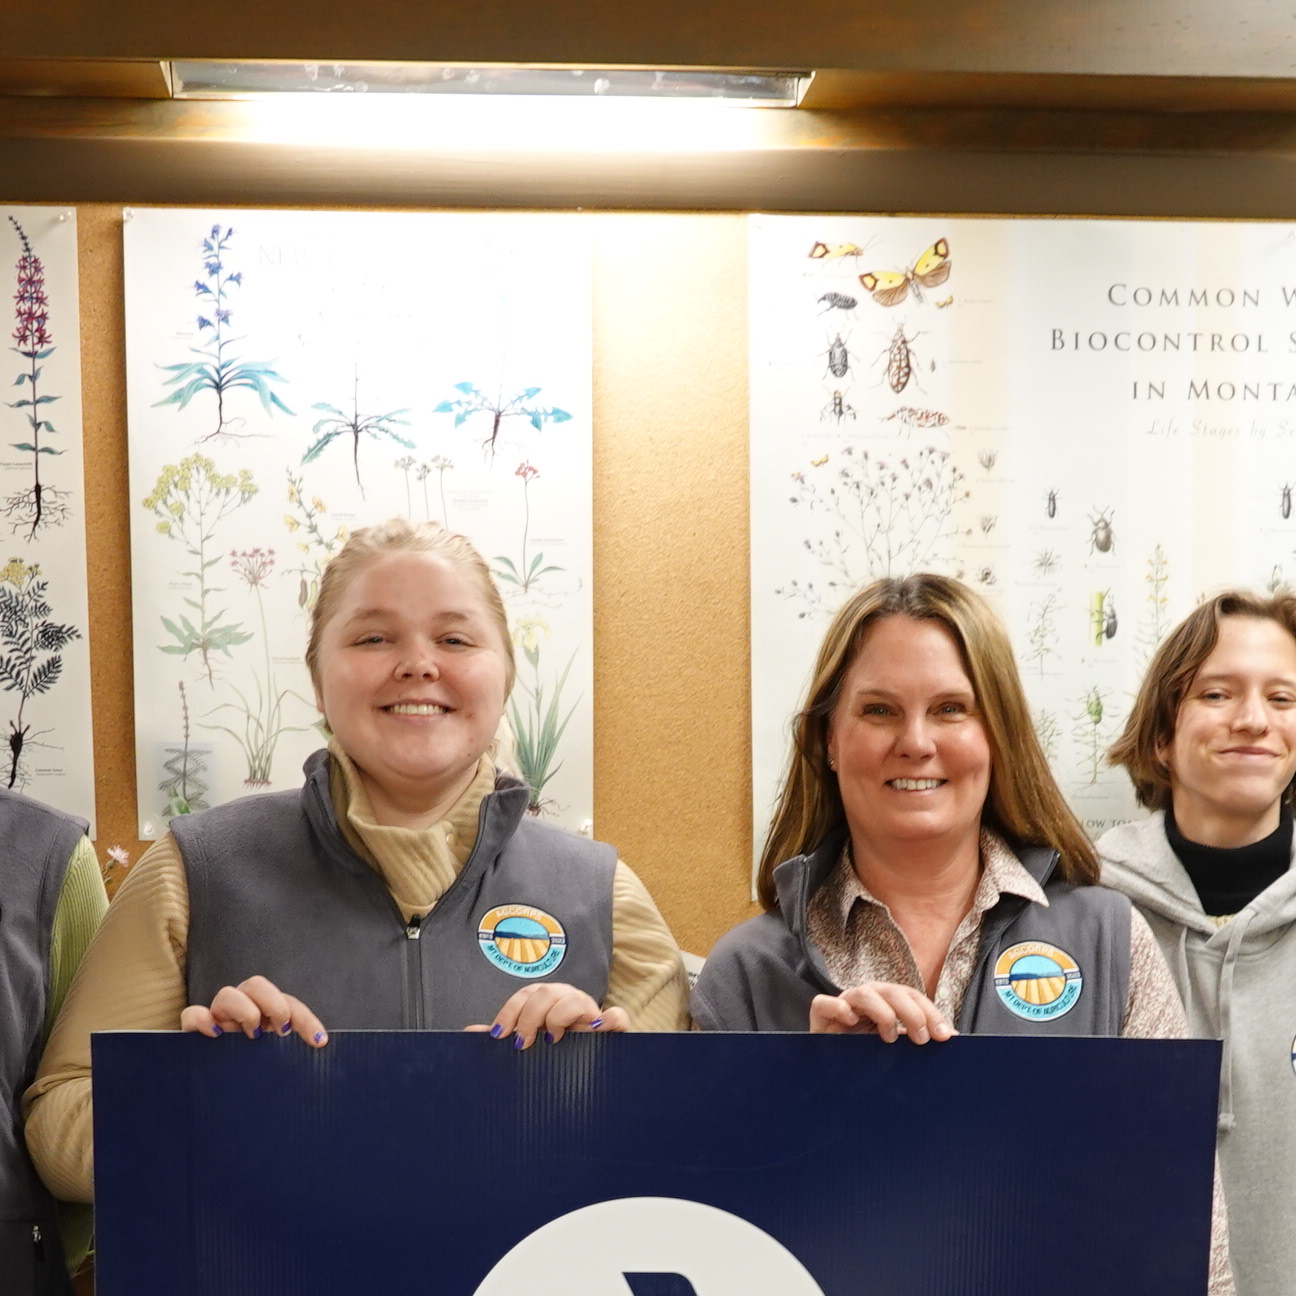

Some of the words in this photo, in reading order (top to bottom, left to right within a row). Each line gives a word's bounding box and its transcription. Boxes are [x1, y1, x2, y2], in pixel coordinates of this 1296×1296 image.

[1107, 283, 1260, 307] COMMON
[1049, 328, 1269, 352] BIOCONTROL
[1132, 381, 1166, 400] IN
[1145, 419, 1181, 437] Life
[1189, 420, 1240, 439] Stages
[1250, 420, 1267, 438] by
